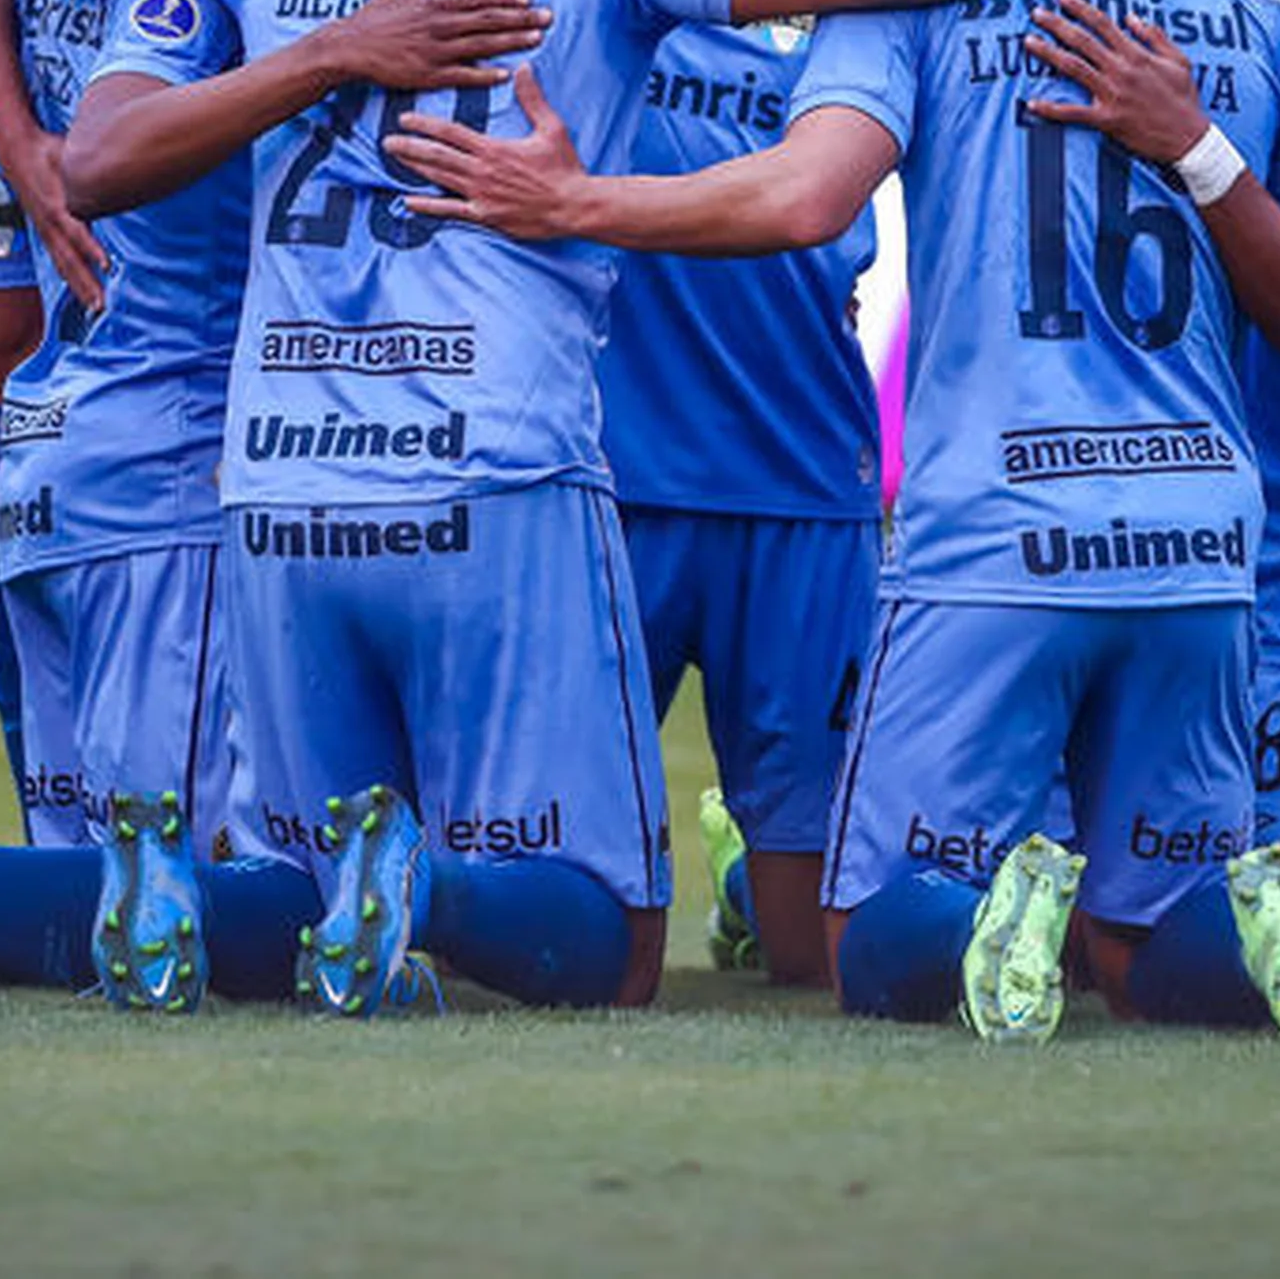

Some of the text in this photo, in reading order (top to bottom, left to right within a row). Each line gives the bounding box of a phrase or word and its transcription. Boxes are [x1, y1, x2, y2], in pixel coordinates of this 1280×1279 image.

[646, 71, 784, 131] anris
[1015, 98, 1196, 354] 16
[261, 331, 475, 367] americanas
[245, 411, 466, 462] Unimed
[1004, 433, 1235, 473] americanas
[244, 503, 470, 558] Unimed
[1021, 517, 1247, 577] Unimed
[906, 809, 1008, 873] bets
[1131, 806, 1245, 865] bets
